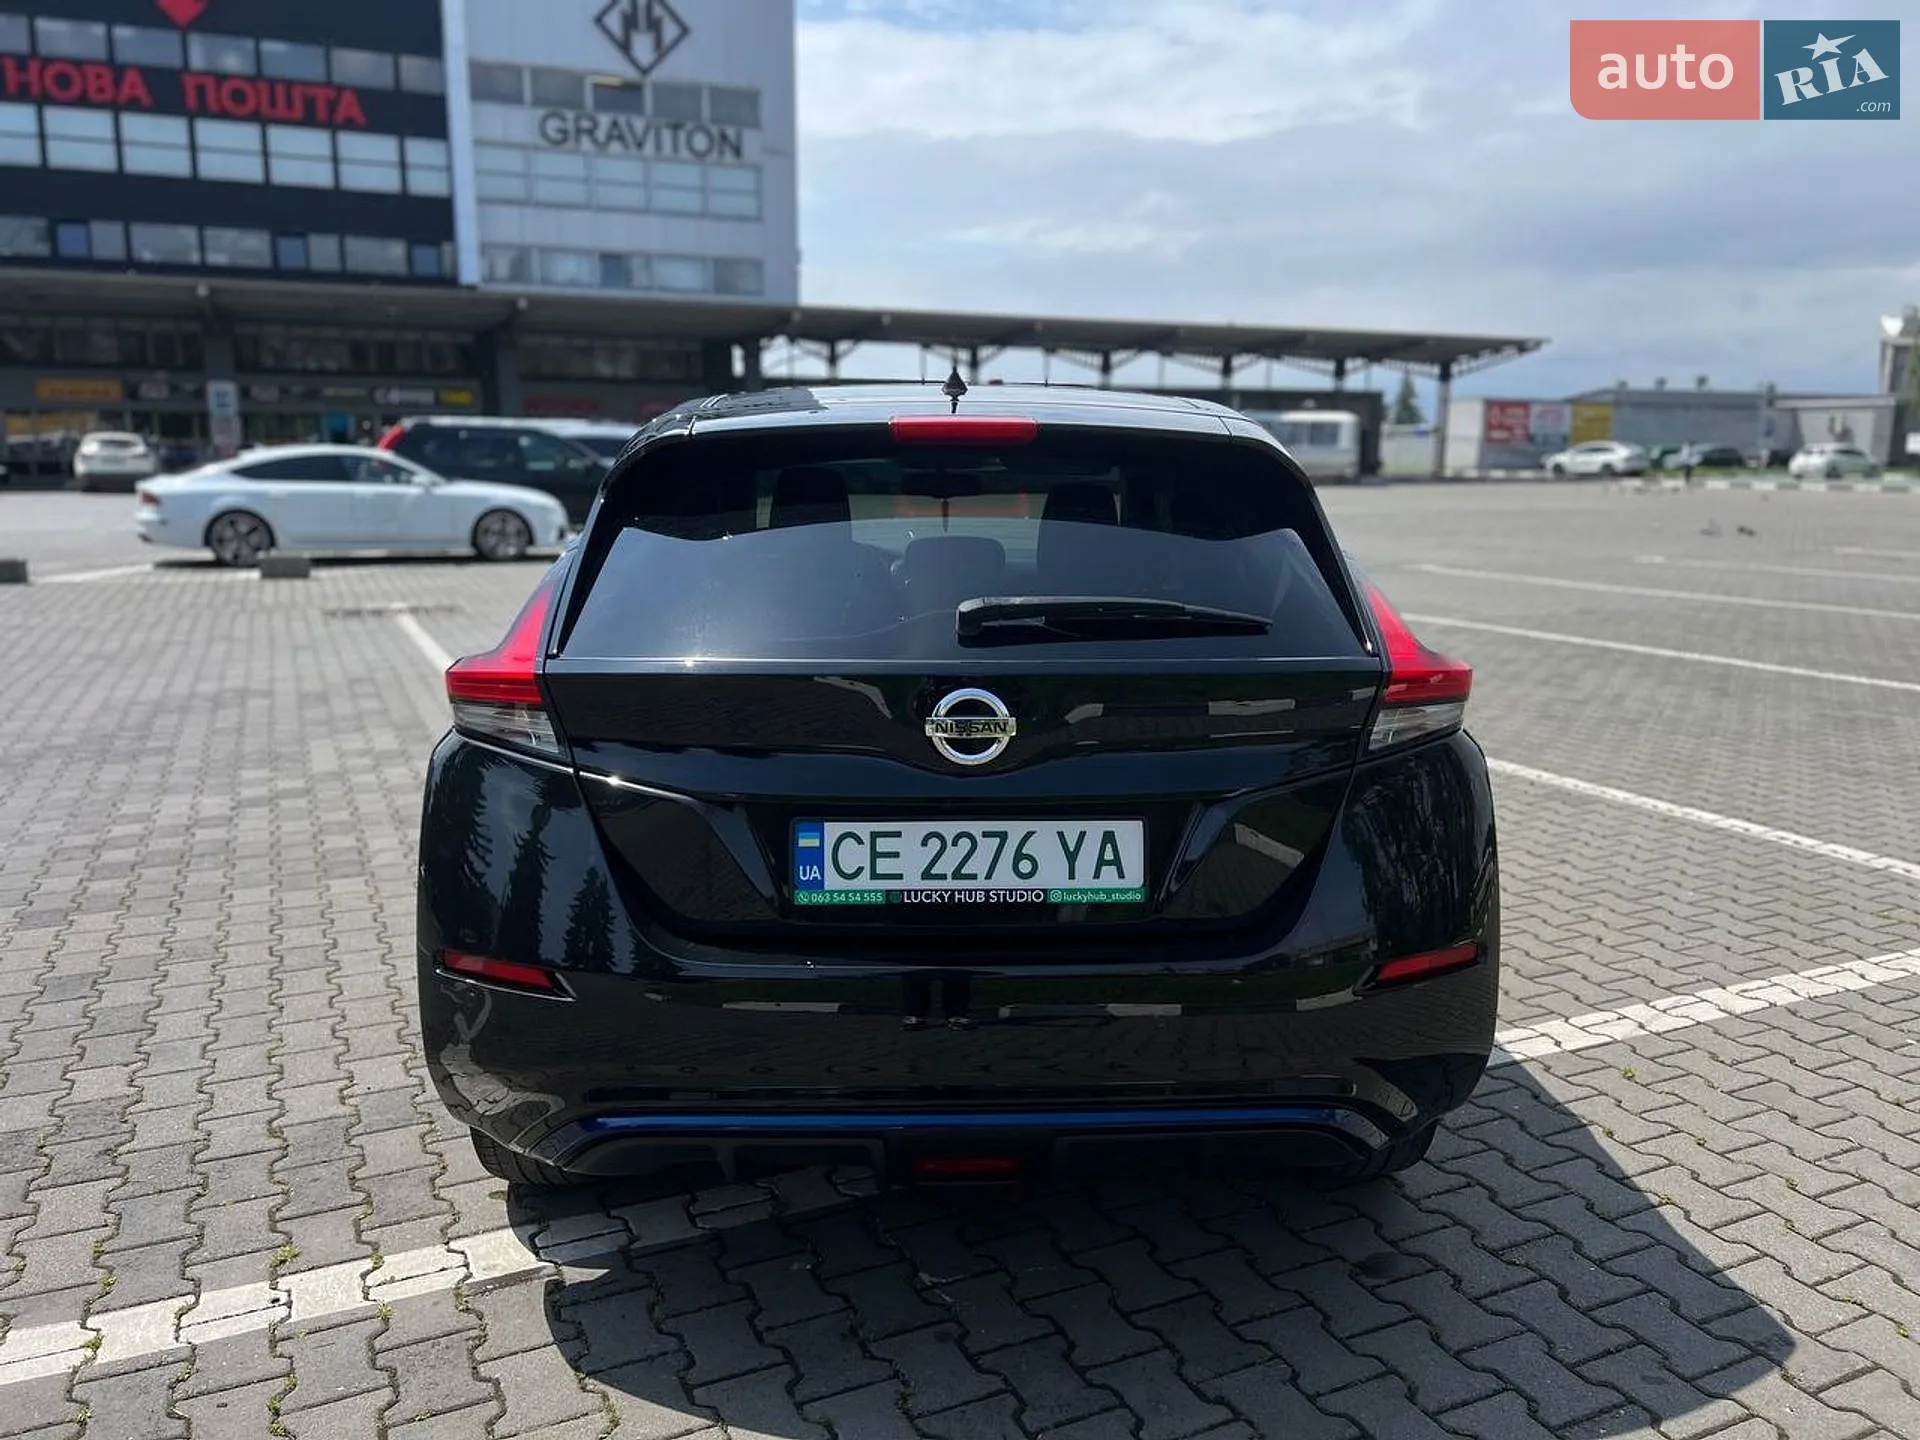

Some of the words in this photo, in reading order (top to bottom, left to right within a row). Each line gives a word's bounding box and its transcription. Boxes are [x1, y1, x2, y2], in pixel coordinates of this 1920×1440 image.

[1, 56, 151, 106] НОВА
[183, 74, 367, 126] ПОШТА
[540, 111, 743, 159] GRAVITON
[934, 721, 1008, 734] NISSAN
[831, 831, 904, 880] CE
[920, 831, 1039, 880] 2276
[1056, 830, 1126, 880] YA
[799, 865, 821, 881] UA
[863, 892, 884, 902] 555
[904, 891, 950, 903] LUCKY
[955, 891, 985, 903] HUB
[989, 890, 1044, 903] STUDIO
